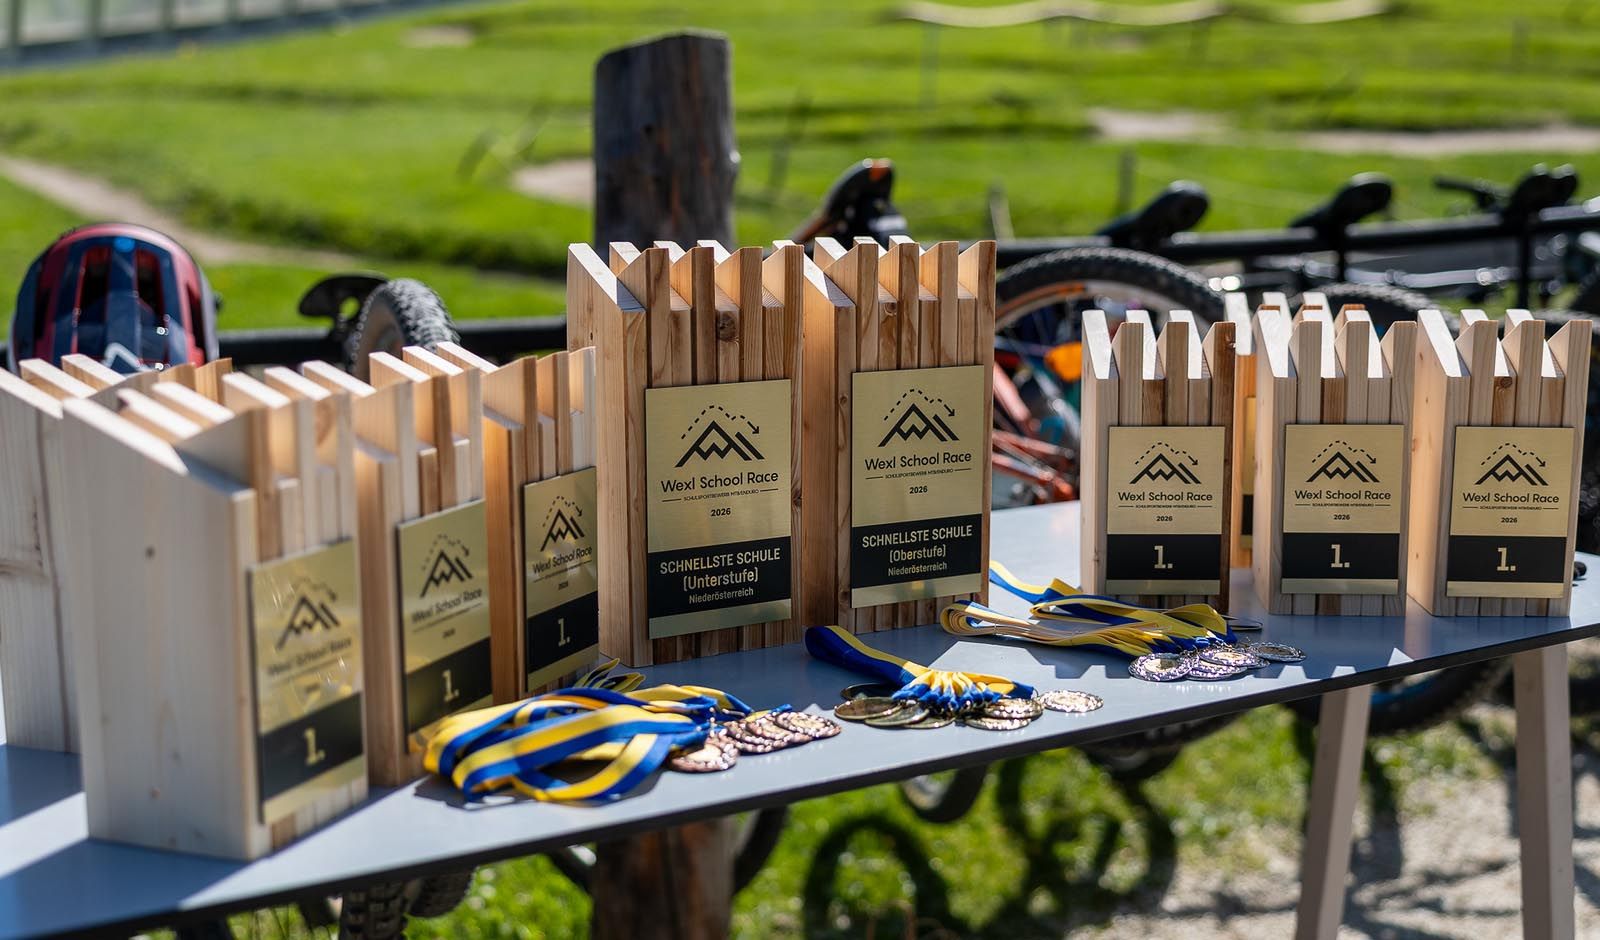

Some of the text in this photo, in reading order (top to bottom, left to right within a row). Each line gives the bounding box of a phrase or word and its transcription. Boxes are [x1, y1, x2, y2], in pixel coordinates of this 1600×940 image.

[864, 452, 972, 471] Wexl School Race
[660, 471, 779, 493] Wexl School Race
[909, 485, 928, 494] 2026
[1118, 491, 1213, 501] Wexl School Race
[1294, 490, 1391, 500] Wexl School Race
[1462, 492, 1560, 503] Wexl School Race
[710, 508, 731, 517] 2026
[862, 525, 973, 548] SCHNELLSTE SCHULE
[552, 550, 575, 567] School
[575, 546, 592, 559] Race
[659, 548, 781, 575] SCHNELLSTE SCHULE
[1154, 545, 1173, 569] 1.
[1331, 544, 1350, 568] 1.
[1497, 547, 1516, 571] 1.
[888, 561, 948, 577] Niederösterreich
[688, 587, 754, 604] Niederösterreich
[558, 617, 570, 647] 1.
[442, 669, 459, 702] 1.
[304, 727, 326, 766] 1.
